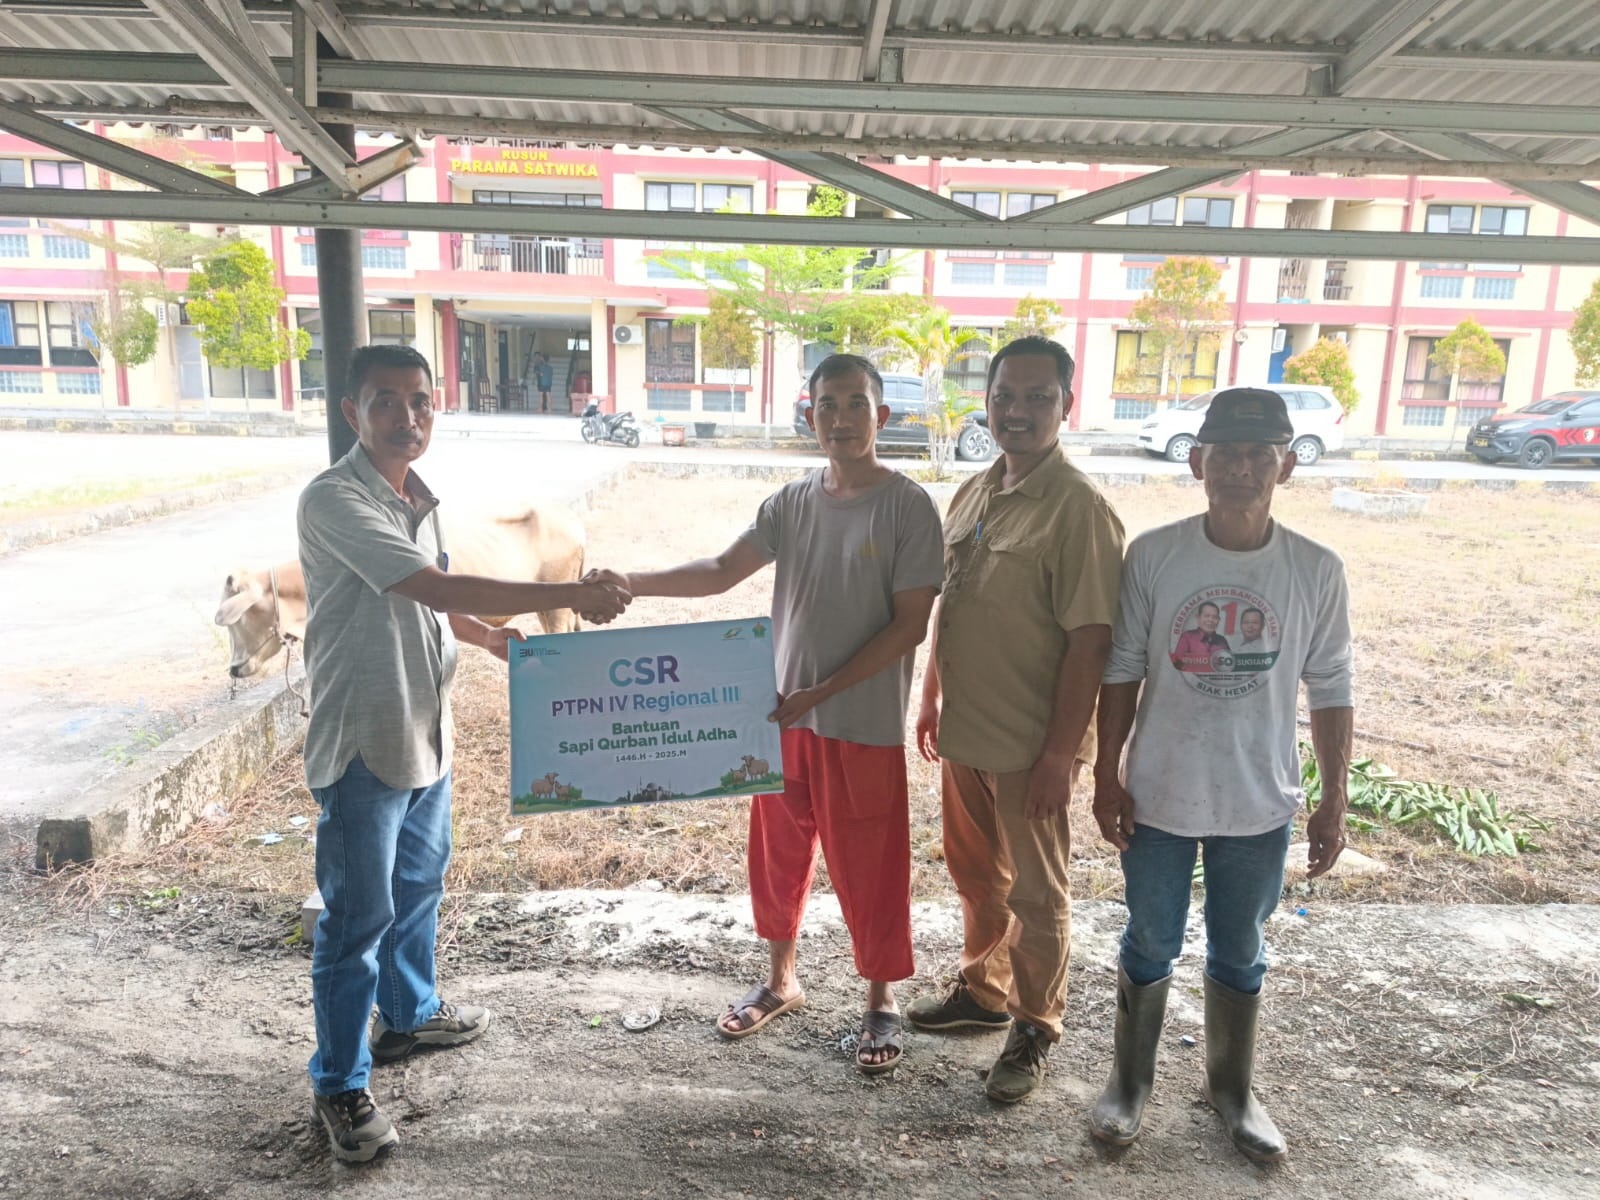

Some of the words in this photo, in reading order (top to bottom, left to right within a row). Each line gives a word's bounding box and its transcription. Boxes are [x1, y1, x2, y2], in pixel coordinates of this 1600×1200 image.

[502, 150, 548, 160] RUSUN
[451, 159, 519, 174] PARAMA
[524, 162, 598, 177] SATWIKA
[1173, 596, 1203, 635] BERSAMA
[1206, 588, 1270, 614] MEMBANGUN
[1220, 601, 1238, 636] 1
[609, 655, 681, 687] CSR
[1196, 682, 1221, 696] SIAK
[1225, 679, 1259, 696] HEBAT
[552, 698, 604, 717] PTPN
[610, 695, 628, 712] IV
[633, 687, 717, 713] Regional
[723, 686, 740, 702] III
[612, 720, 680, 735] Bantuan
[559, 738, 594, 756] Sapi
[598, 733, 657, 751] Qurban
[662, 729, 694, 745] Idul
[696, 727, 737, 742] Adha
[615, 752, 646, 762] 1446.H
[655, 750, 687, 760] 2025.M
